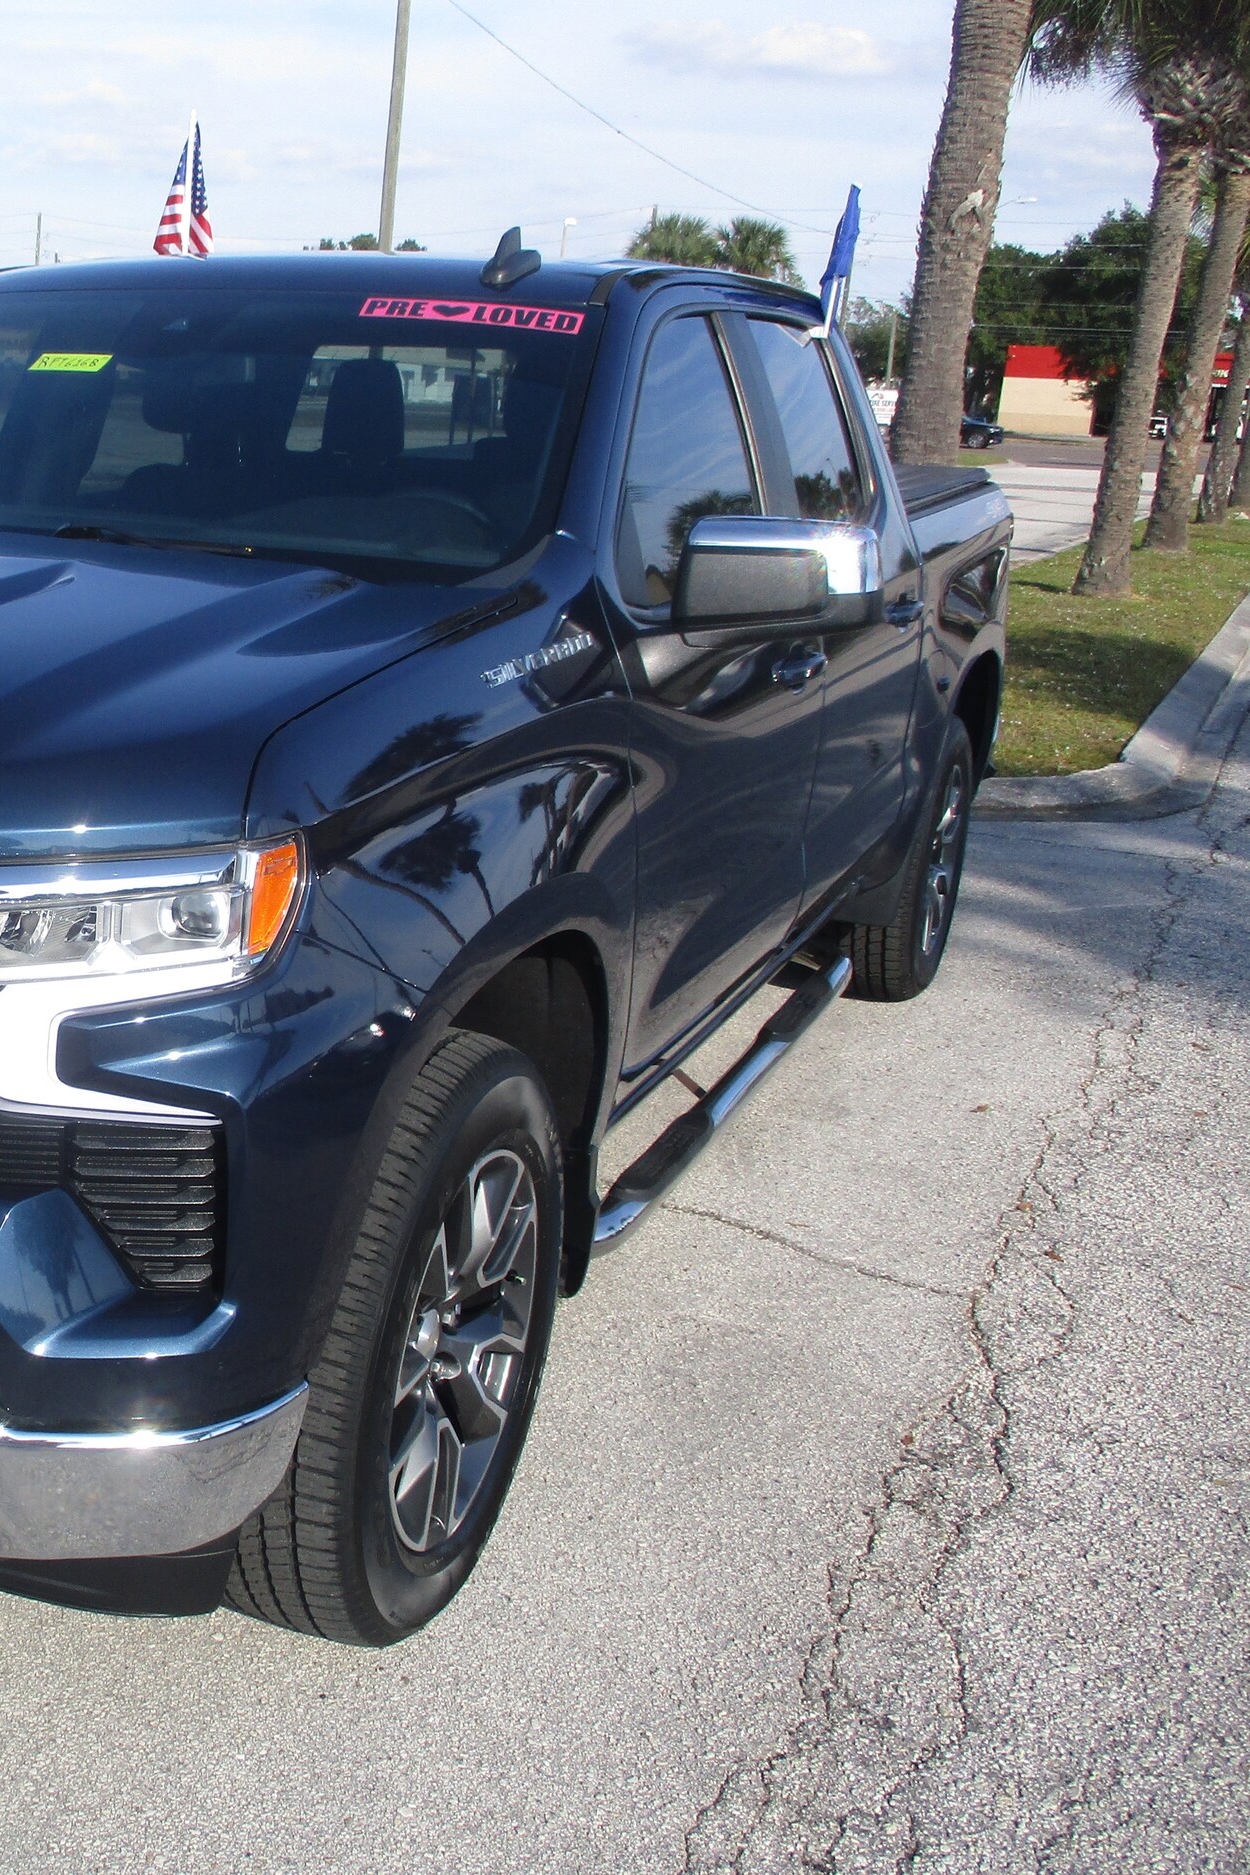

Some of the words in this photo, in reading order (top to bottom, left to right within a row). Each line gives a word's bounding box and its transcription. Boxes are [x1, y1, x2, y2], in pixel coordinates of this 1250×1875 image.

[364, 300, 428, 317] PRE
[472, 305, 578, 331] LOVED
[481, 632, 593, 688] SILVERADO
